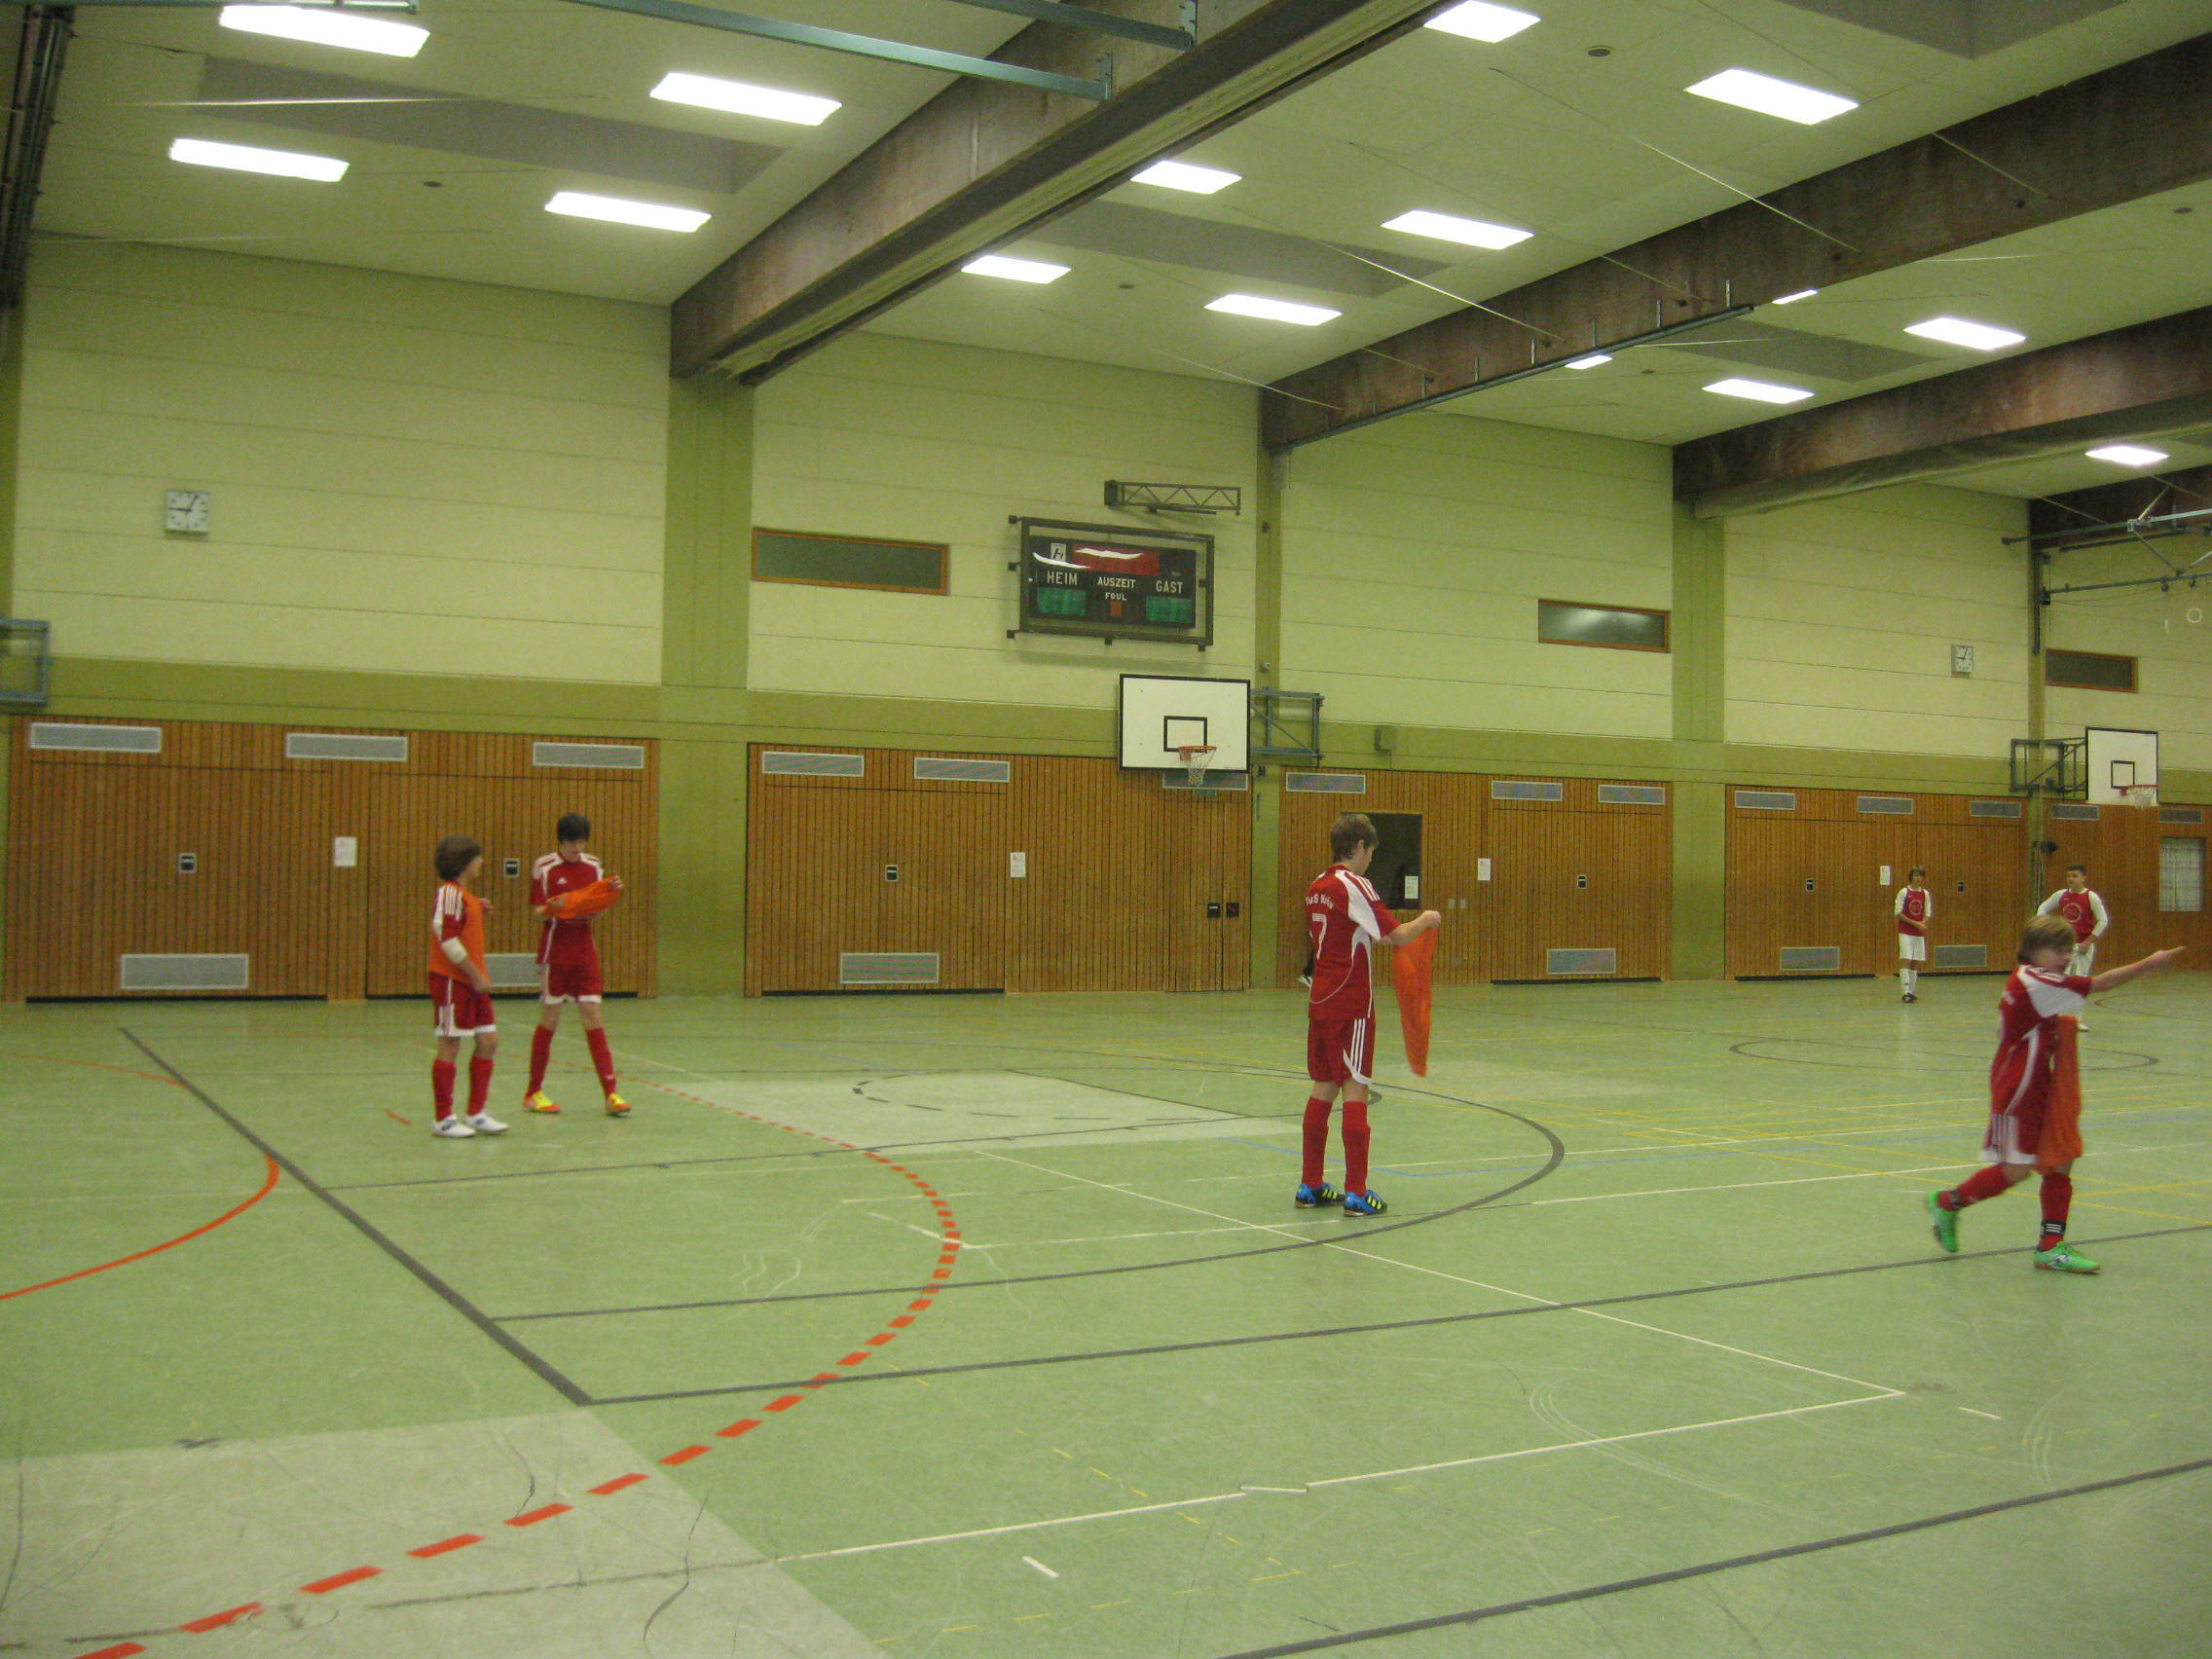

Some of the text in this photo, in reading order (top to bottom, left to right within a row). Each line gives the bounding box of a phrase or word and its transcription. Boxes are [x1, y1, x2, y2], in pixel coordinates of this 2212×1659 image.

[1047, 570, 1078, 586] HEIM
[1097, 575, 1136, 589] AUSZEIT
[1156, 579, 1184, 594] GAST
[1105, 592, 1127, 601] FOUL
[1311, 912, 1327, 961] 7
